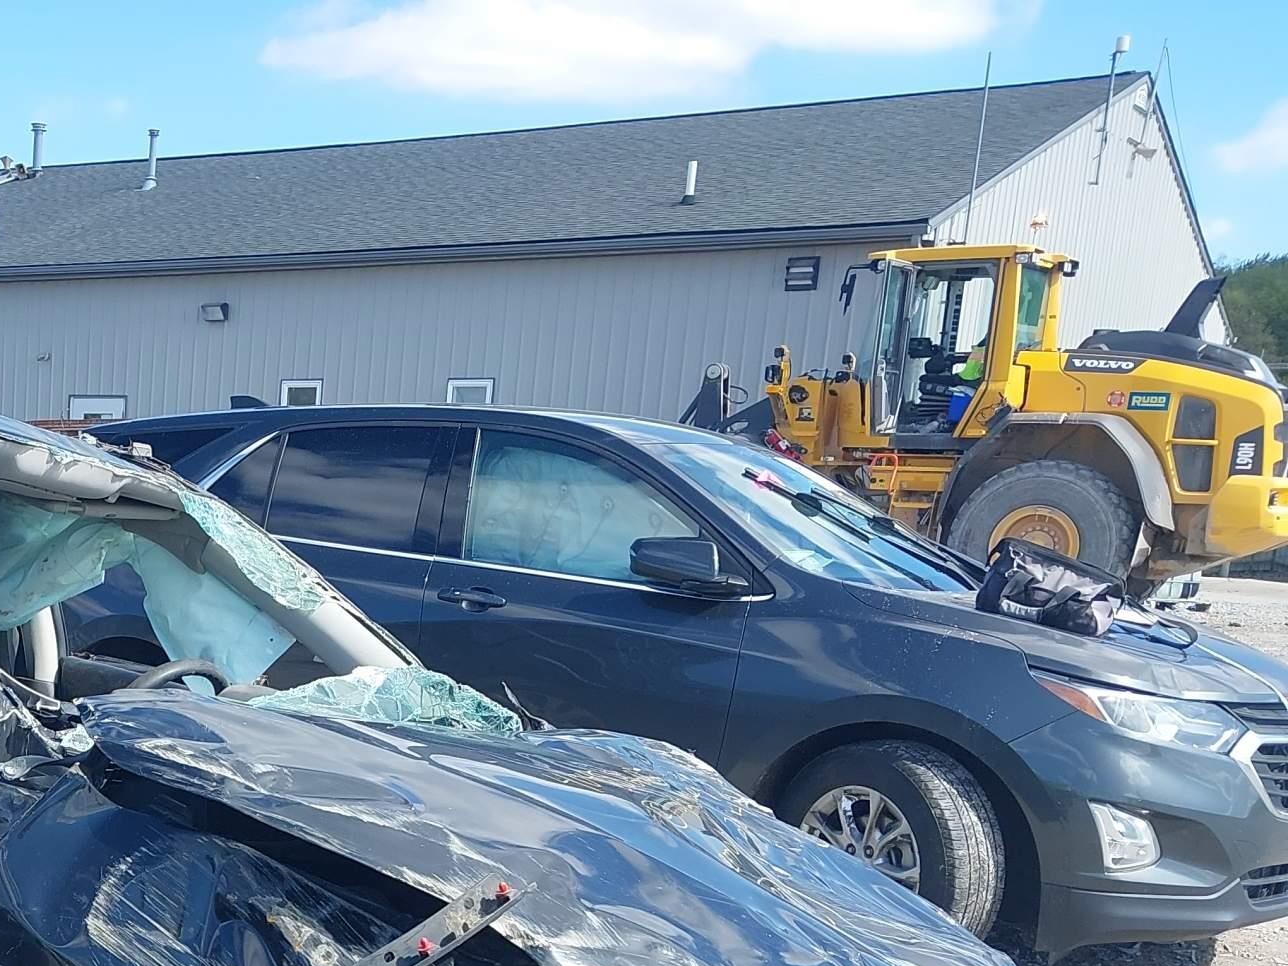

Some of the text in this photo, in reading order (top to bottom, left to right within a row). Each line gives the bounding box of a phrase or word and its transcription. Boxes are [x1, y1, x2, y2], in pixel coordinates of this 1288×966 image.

[1072, 358, 1135, 370] VOLVO
[1131, 395, 1166, 407] RUDD
[1234, 442, 1257, 470] L90H
